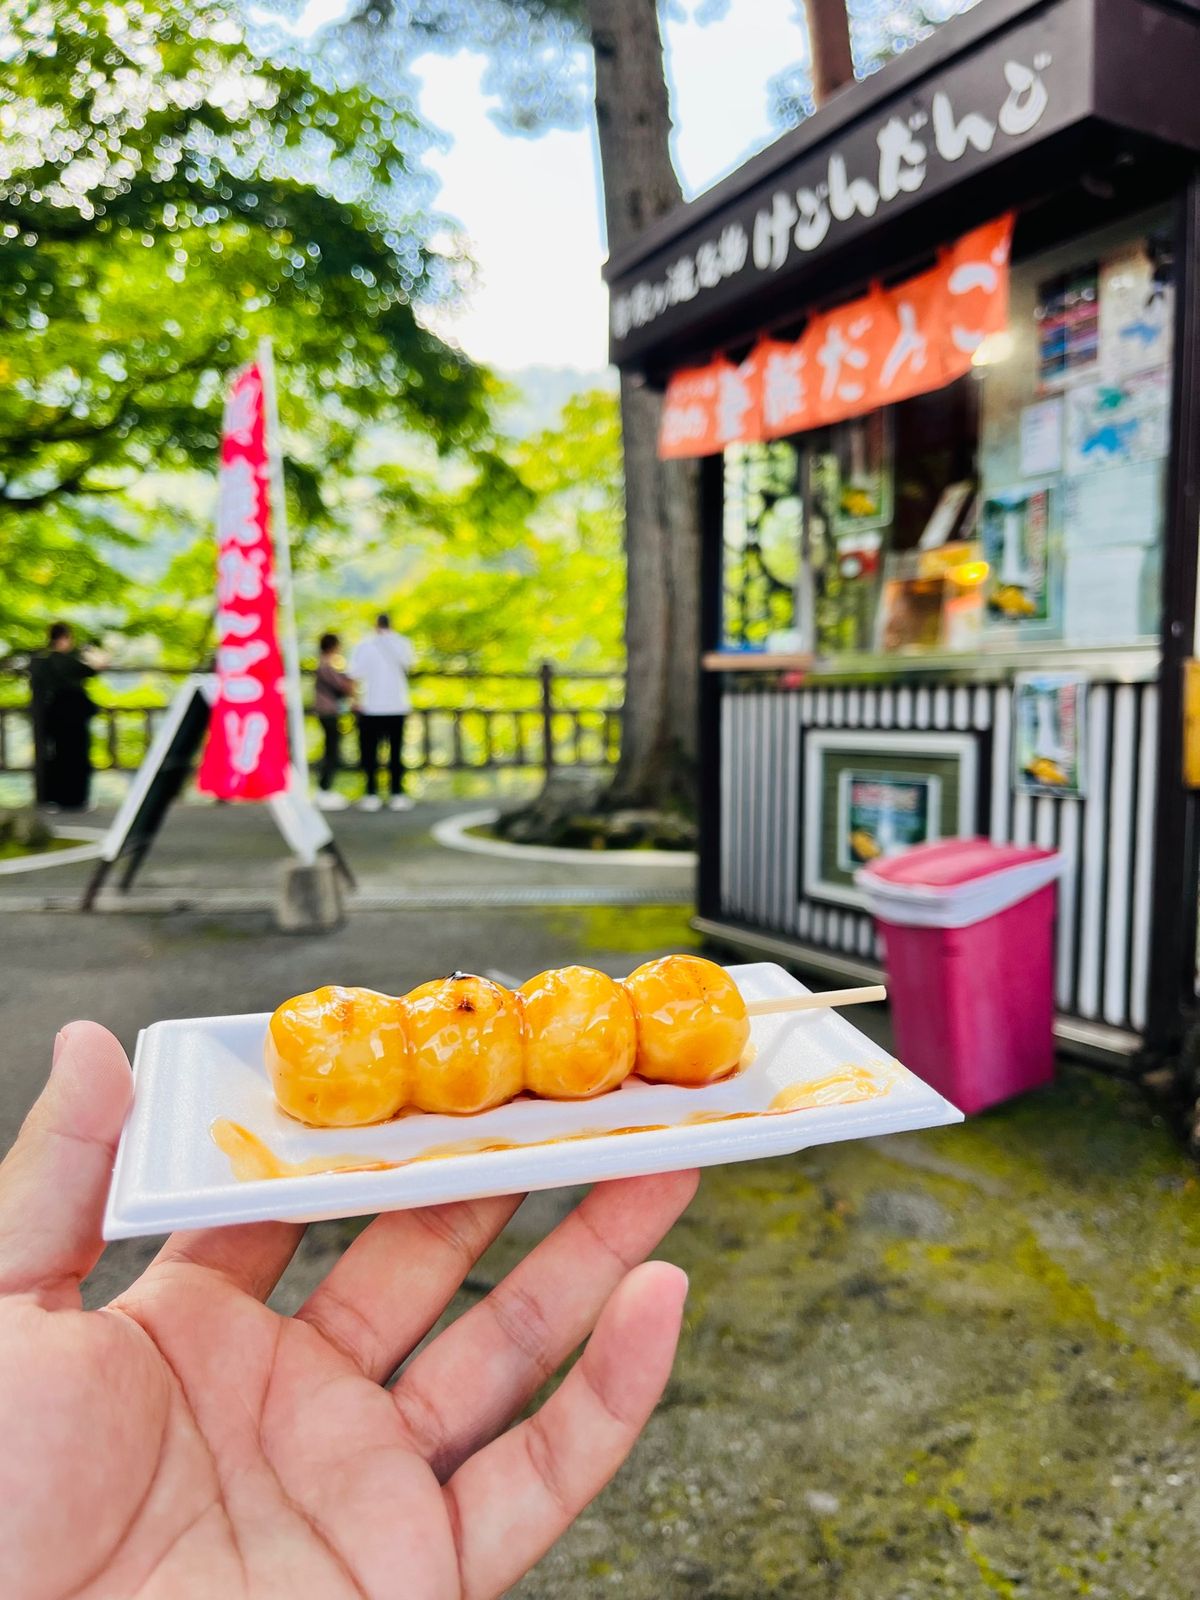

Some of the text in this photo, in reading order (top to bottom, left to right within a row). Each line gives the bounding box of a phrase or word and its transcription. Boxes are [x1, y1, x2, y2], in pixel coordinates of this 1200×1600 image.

[753, 51, 1053, 272] けごんだんご
